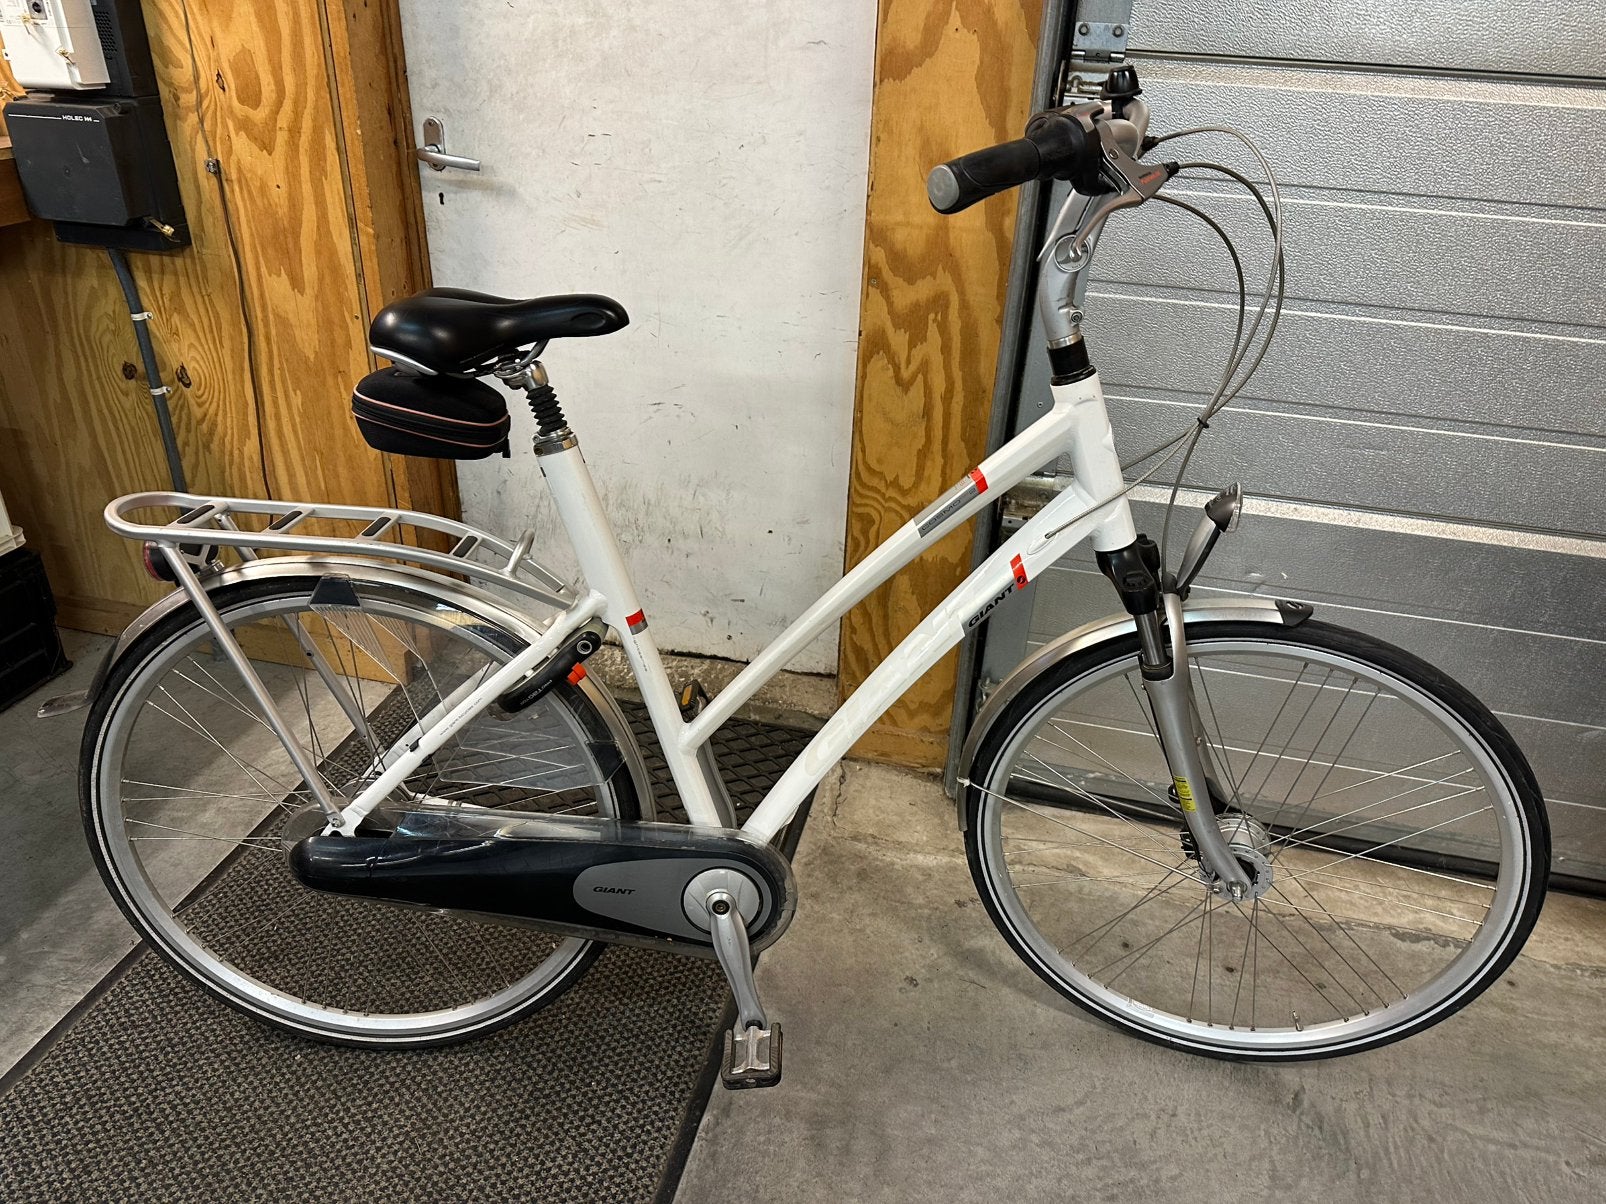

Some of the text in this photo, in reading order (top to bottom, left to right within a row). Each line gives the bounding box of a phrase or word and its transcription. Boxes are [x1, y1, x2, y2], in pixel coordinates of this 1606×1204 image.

[922, 499, 961, 531] COSMO
[968, 583, 1015, 628] GIANT
[593, 886, 636, 895] GIANT
